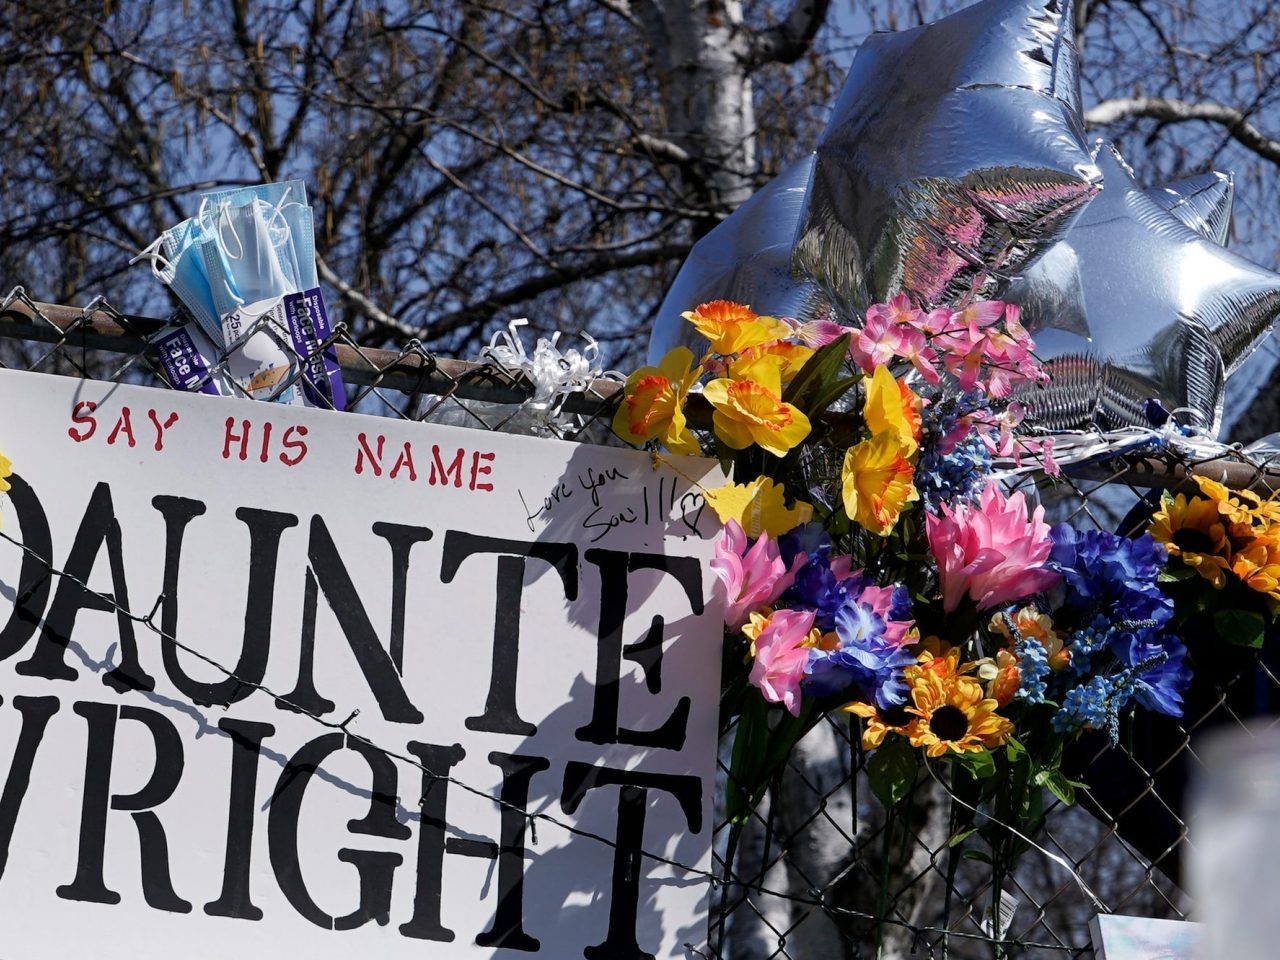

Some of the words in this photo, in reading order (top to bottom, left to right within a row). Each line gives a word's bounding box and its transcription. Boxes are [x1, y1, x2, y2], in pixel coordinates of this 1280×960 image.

[230, 314, 242, 330] 25
[296, 296, 314, 336] Face
[305, 338, 325, 385] Mask
[166, 337, 191, 375] Face
[68, 400, 179, 452] SAY
[221, 416, 309, 467] HIS
[354, 432, 497, 491] NAME
[518, 482, 573, 532] Love
